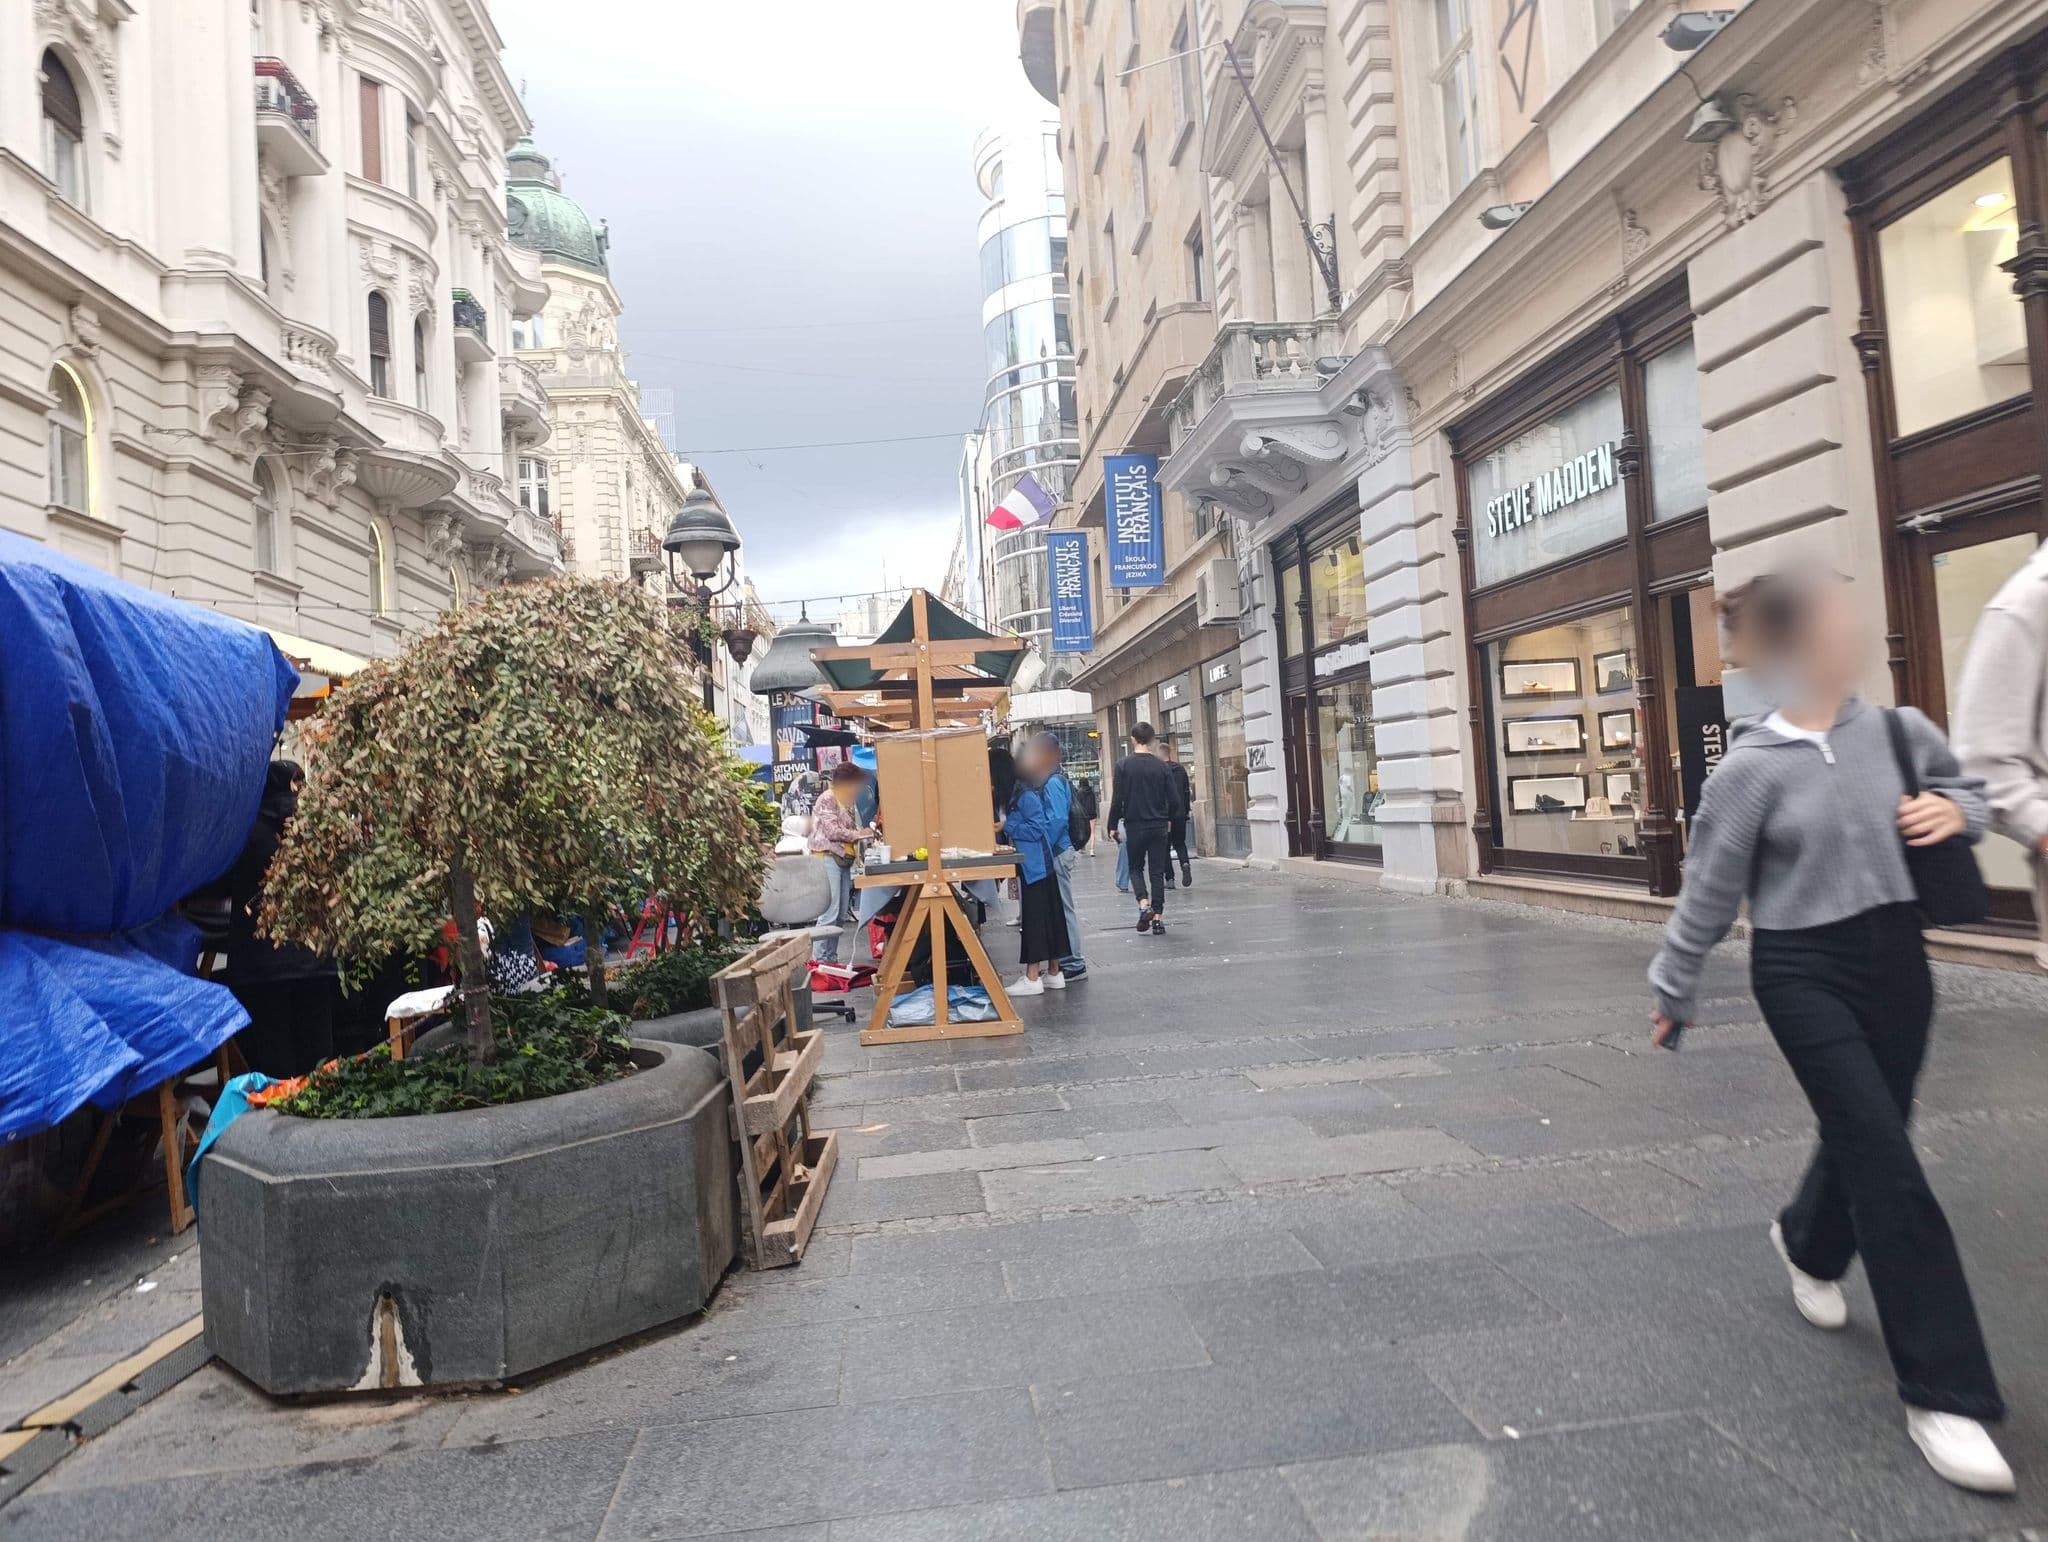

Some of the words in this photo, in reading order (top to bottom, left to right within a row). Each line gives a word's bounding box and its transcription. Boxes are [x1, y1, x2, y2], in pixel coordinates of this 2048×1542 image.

[1486, 482, 1533, 538] STEVE
[1536, 442, 1613, 516] MADDEN
[1115, 473, 1134, 543] INSTITUT
[1056, 547, 1069, 598] INSTITUT
[1114, 563, 1157, 571] FRANCUSKOG
[1125, 555, 1146, 563] ŠKOLA
[1126, 571, 1147, 579] JEZIKA
